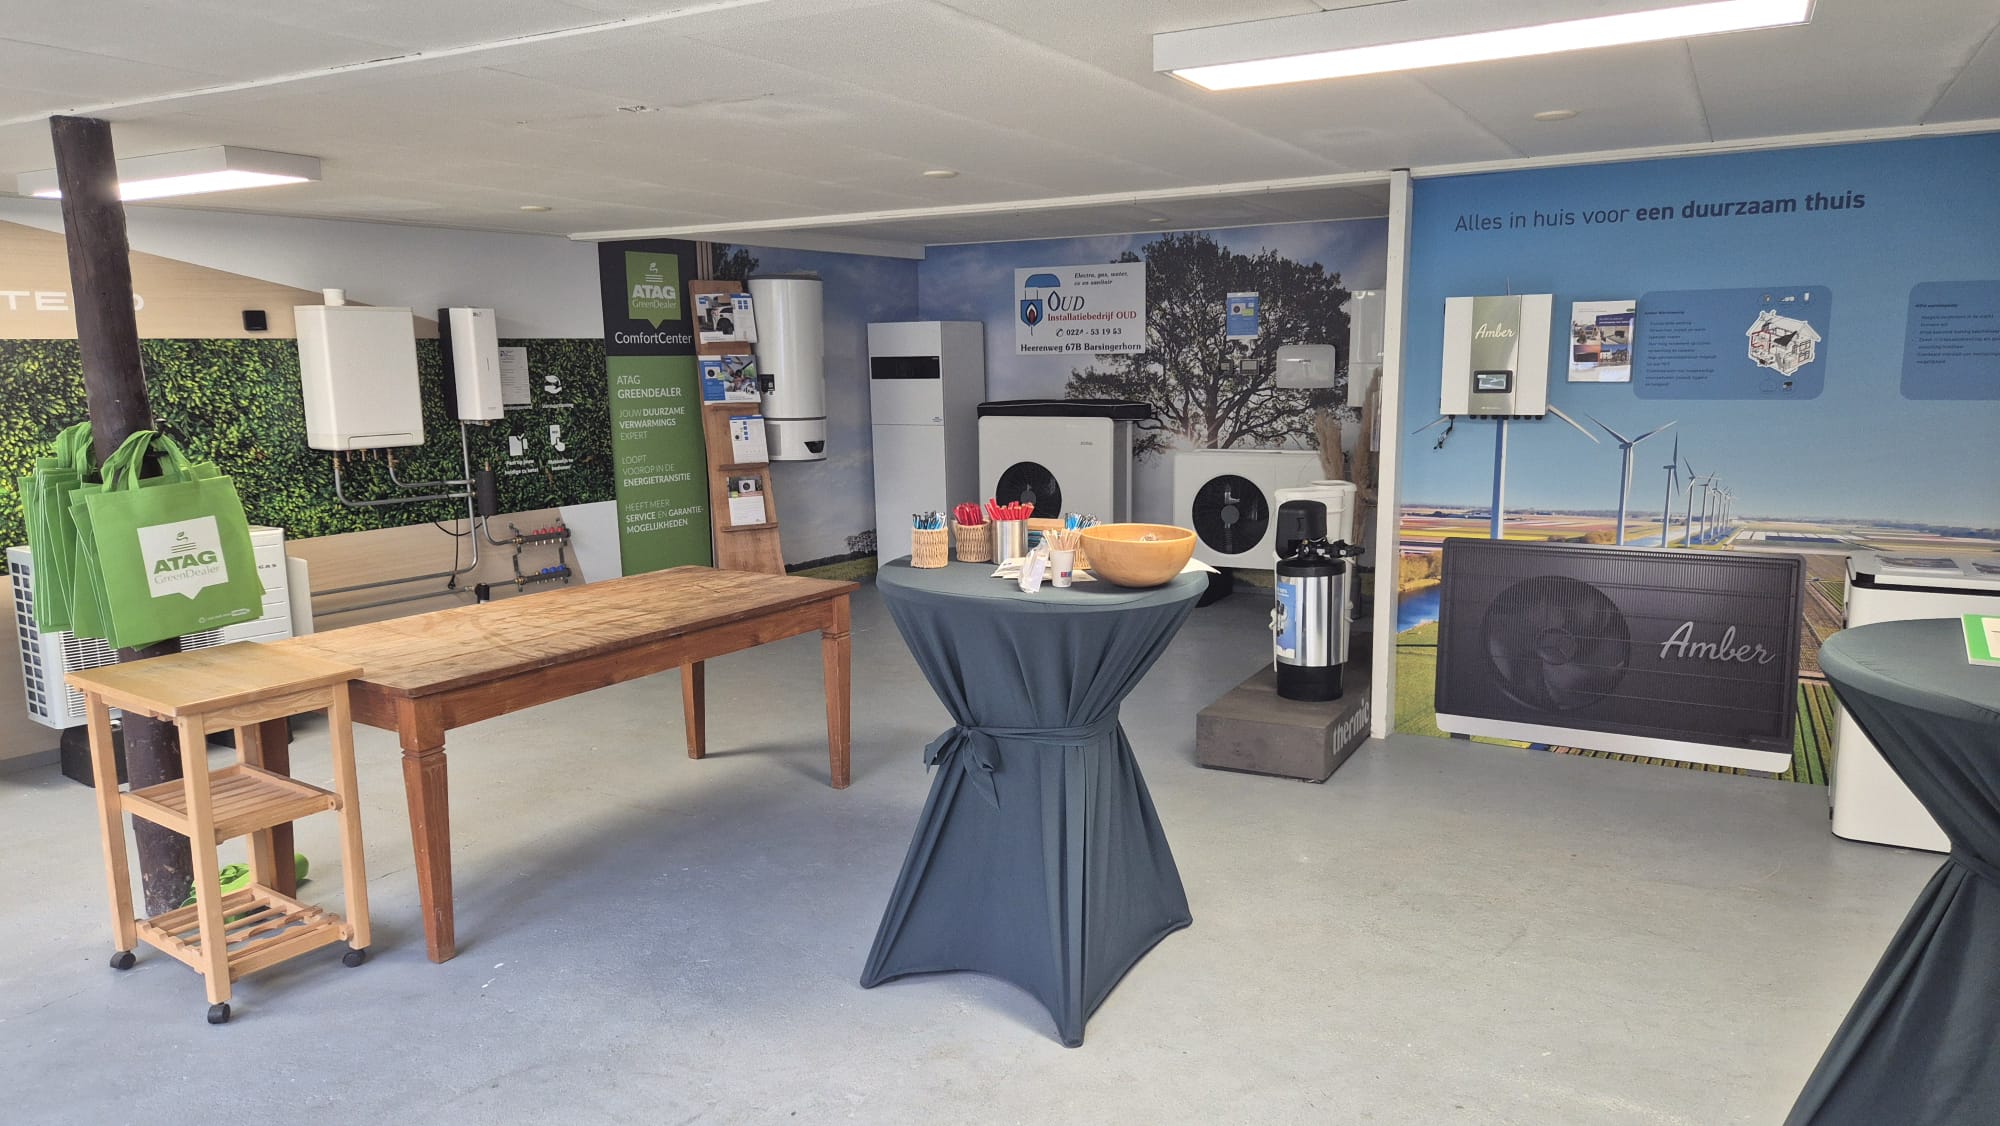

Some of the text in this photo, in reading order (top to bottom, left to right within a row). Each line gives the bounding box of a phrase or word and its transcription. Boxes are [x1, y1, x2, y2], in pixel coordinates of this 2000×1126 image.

[1454, 190, 1866, 233] Alles in huis voor een duurzaam thuis
[632, 284, 676, 299] ATAG
[632, 299, 677, 309] GreenDealer
[1047, 310, 1137, 322] Installatiebedrijf OUD
[614, 331, 692, 344] ComfortCenter
[1102, 327, 1111, 335] 19
[1474, 323, 1517, 340] Amber
[1020, 342, 1142, 353] Heerenweg 67B Barsingerhorn
[616, 375, 641, 385] ATAG
[617, 387, 682, 399] GREENDEALER
[619, 407, 686, 418] JOUW DUURZAME
[619, 418, 677, 429] VERWARMINGS
[620, 431, 648, 441] EXPERT
[622, 454, 647, 464] LOOPT
[622, 463, 675, 476] VOOROP IN DE
[623, 473, 692, 487] ENERGIETRANSITIE
[625, 499, 671, 511] HEEFT MEER
[625, 506, 704, 523] SERVICE EN GARANTIE-
[626, 518, 688, 534] MOGELIJKHEDEN
[153, 550, 218, 575] ATAG
[153, 565, 220, 585] GreenDealer
[1660, 621, 1776, 664] Amber
[1332, 699, 1370, 756] thermic
